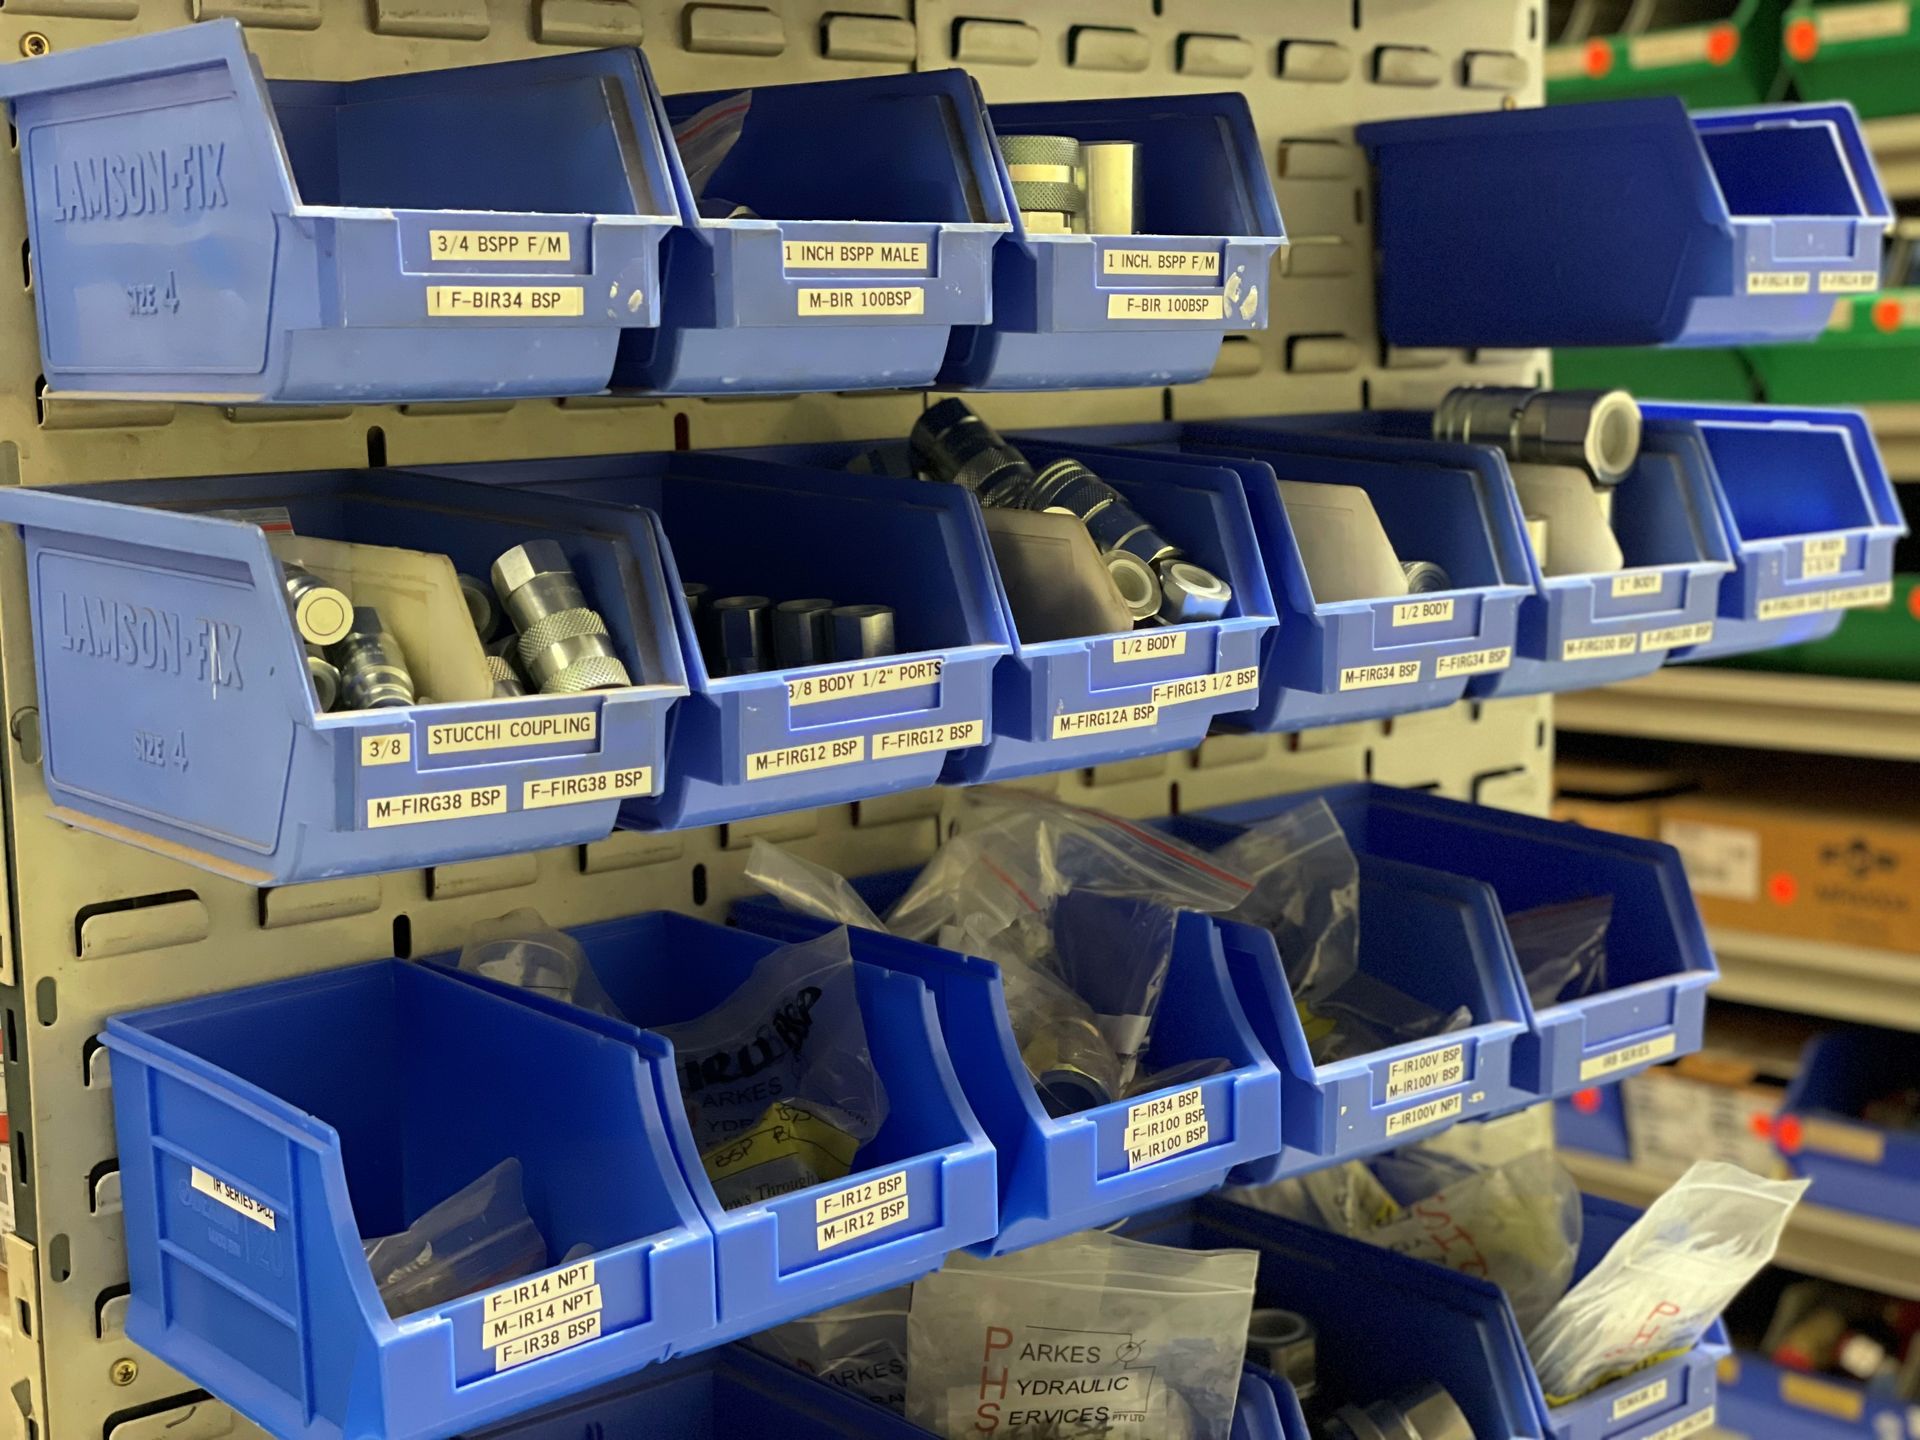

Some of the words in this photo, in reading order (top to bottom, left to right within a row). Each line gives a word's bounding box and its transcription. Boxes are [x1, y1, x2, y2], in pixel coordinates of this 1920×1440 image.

[437, 236, 469, 254] 3/4
[478, 235, 519, 253] BSPP
[527, 234, 562, 254] F/M
[784, 245, 793, 262] 1
[801, 245, 834, 263] INCH
[840, 244, 874, 262] BSPP
[880, 244, 920, 263] MALE
[1107, 254, 1115, 269] 1
[1121, 254, 1152, 269] INCH.
[1158, 253, 1187, 269] BSPP
[1191, 253, 1216, 270] F/M
[163, 269, 181, 314] 4
[451, 289, 522, 309] F-BIR34
[531, 290, 561, 309] BSP
[809, 291, 854, 309] M-BIR
[860, 290, 912, 308] 100BSP
[1127, 298, 1162, 313] F-BIR
[1167, 297, 1209, 313] 100BSP
[1633, 575, 1657, 590] BODY
[1401, 605, 1419, 620] 1/2
[1422, 602, 1449, 617] BODY
[1121, 639, 1142, 656] 1/2
[1147, 634, 1177, 651] BODY
[1345, 666, 1395, 684] M-FIRG34
[1399, 663, 1418, 677] BSP
[1438, 654, 1485, 672] F-FIRG34
[1488, 649, 1507, 664] BSP
[788, 682, 812, 700] 3/8
[819, 674, 855, 694] BODY
[900, 661, 942, 681] PORTS
[1153, 679, 1207, 702] F-FIRG13
[1212, 673, 1232, 691] 1/2
[1237, 669, 1257, 686] BSP
[433, 723, 501, 745] STUCCHI
[510, 716, 591, 738] COUPLING
[1060, 709, 1128, 732] M-FIRG12A
[1133, 705, 1155, 721] BSP
[173, 729, 189, 772] 4
[369, 739, 401, 759] 3/8
[881, 728, 944, 751] F-FIRG12
[949, 723, 974, 741] BSP
[756, 745, 826, 771] M-FIRG12
[832, 740, 857, 758] BSP
[531, 775, 607, 799] F-FIRG38
[614, 770, 643, 789] BSP
[376, 794, 462, 818] M-FIRG38
[471, 790, 501, 807] BSP
[1392, 1053, 1438, 1077] F-IR100V
[1443, 1047, 1460, 1063] BSP
[1620, 1043, 1651, 1063] SERIES
[1389, 1072, 1438, 1098] M-IR100V
[1442, 1065, 1460, 1082] BSP
[1133, 1097, 1173, 1122] F-IR34
[1178, 1090, 1198, 1108] BSP
[1389, 1103, 1436, 1130] F-IR100V
[1441, 1096, 1459, 1113] NPT
[1132, 1116, 1180, 1142] F-IR100
[1185, 1108, 1206, 1125] BSP
[1131, 1135, 1181, 1164] M-IR100
[1186, 1125, 1206, 1143] BSP
[212, 1178, 222, 1193] IR
[224, 1183, 254, 1211] SERIES
[824, 1186, 872, 1214] F-IR12
[878, 1176, 902, 1196] BSP
[823, 1211, 874, 1242] M-IR12
[880, 1200, 905, 1221] BSP
[492, 1278, 550, 1312] F-IR14
[557, 1264, 588, 1289] NPT
[494, 1303, 555, 1338] M-IR14
[563, 1289, 594, 1314] NPT
[503, 1329, 560, 1362] F-IR38
[567, 1317, 596, 1340] BSP
[1112, 1414, 1128, 1422] PTY
[1129, 1414, 1146, 1423] LTD
